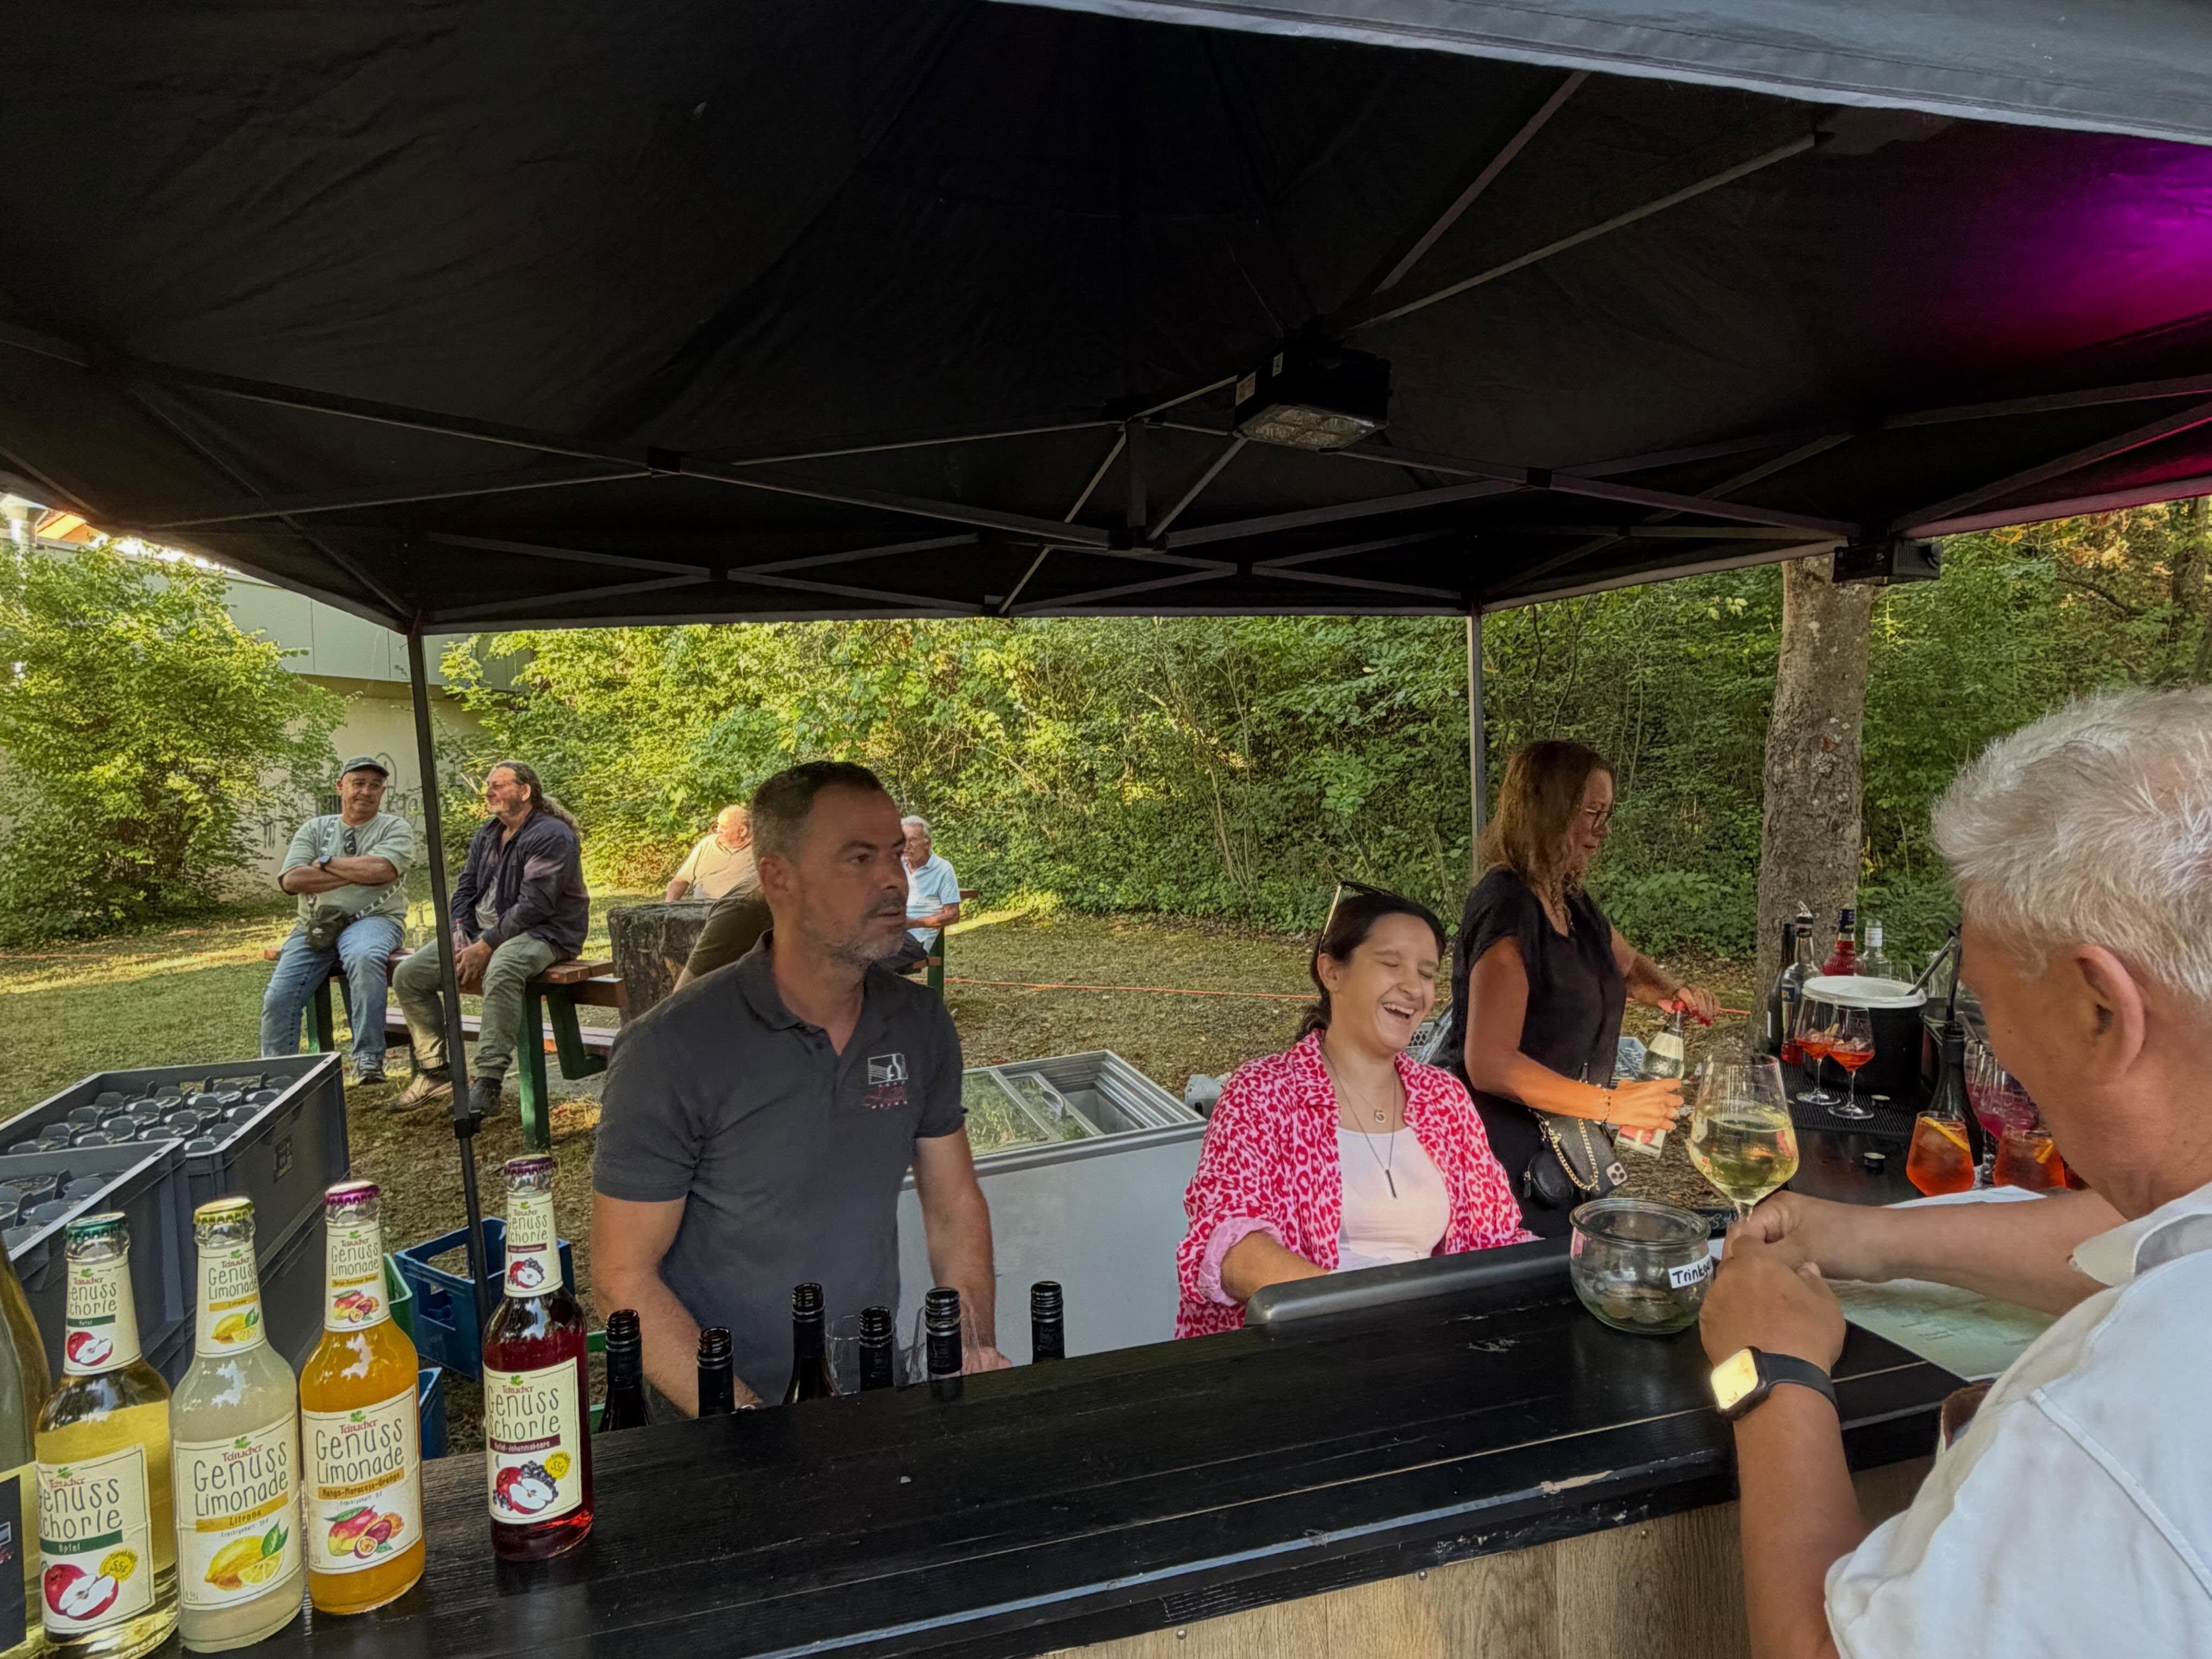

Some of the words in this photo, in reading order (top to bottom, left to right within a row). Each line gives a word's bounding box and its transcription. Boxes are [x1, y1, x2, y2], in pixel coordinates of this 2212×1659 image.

[331, 1242, 378, 1263] Genuss
[332, 1257, 379, 1276] Limonade
[68, 1299, 117, 1317] chorle
[488, 1385, 559, 1417] Genuss
[339, 1419, 379, 1434] Teinacher
[488, 1414, 561, 1441] Schorle
[316, 1418, 402, 1461] Genuss
[222, 1444, 264, 1462] Teinacher
[194, 1441, 287, 1492] Genuss
[317, 1445, 404, 1484] Limonade
[195, 1470, 288, 1516] Limonade
[229, 1509, 262, 1526] Zitrone
[58, 1543, 81, 1553] Apfel
